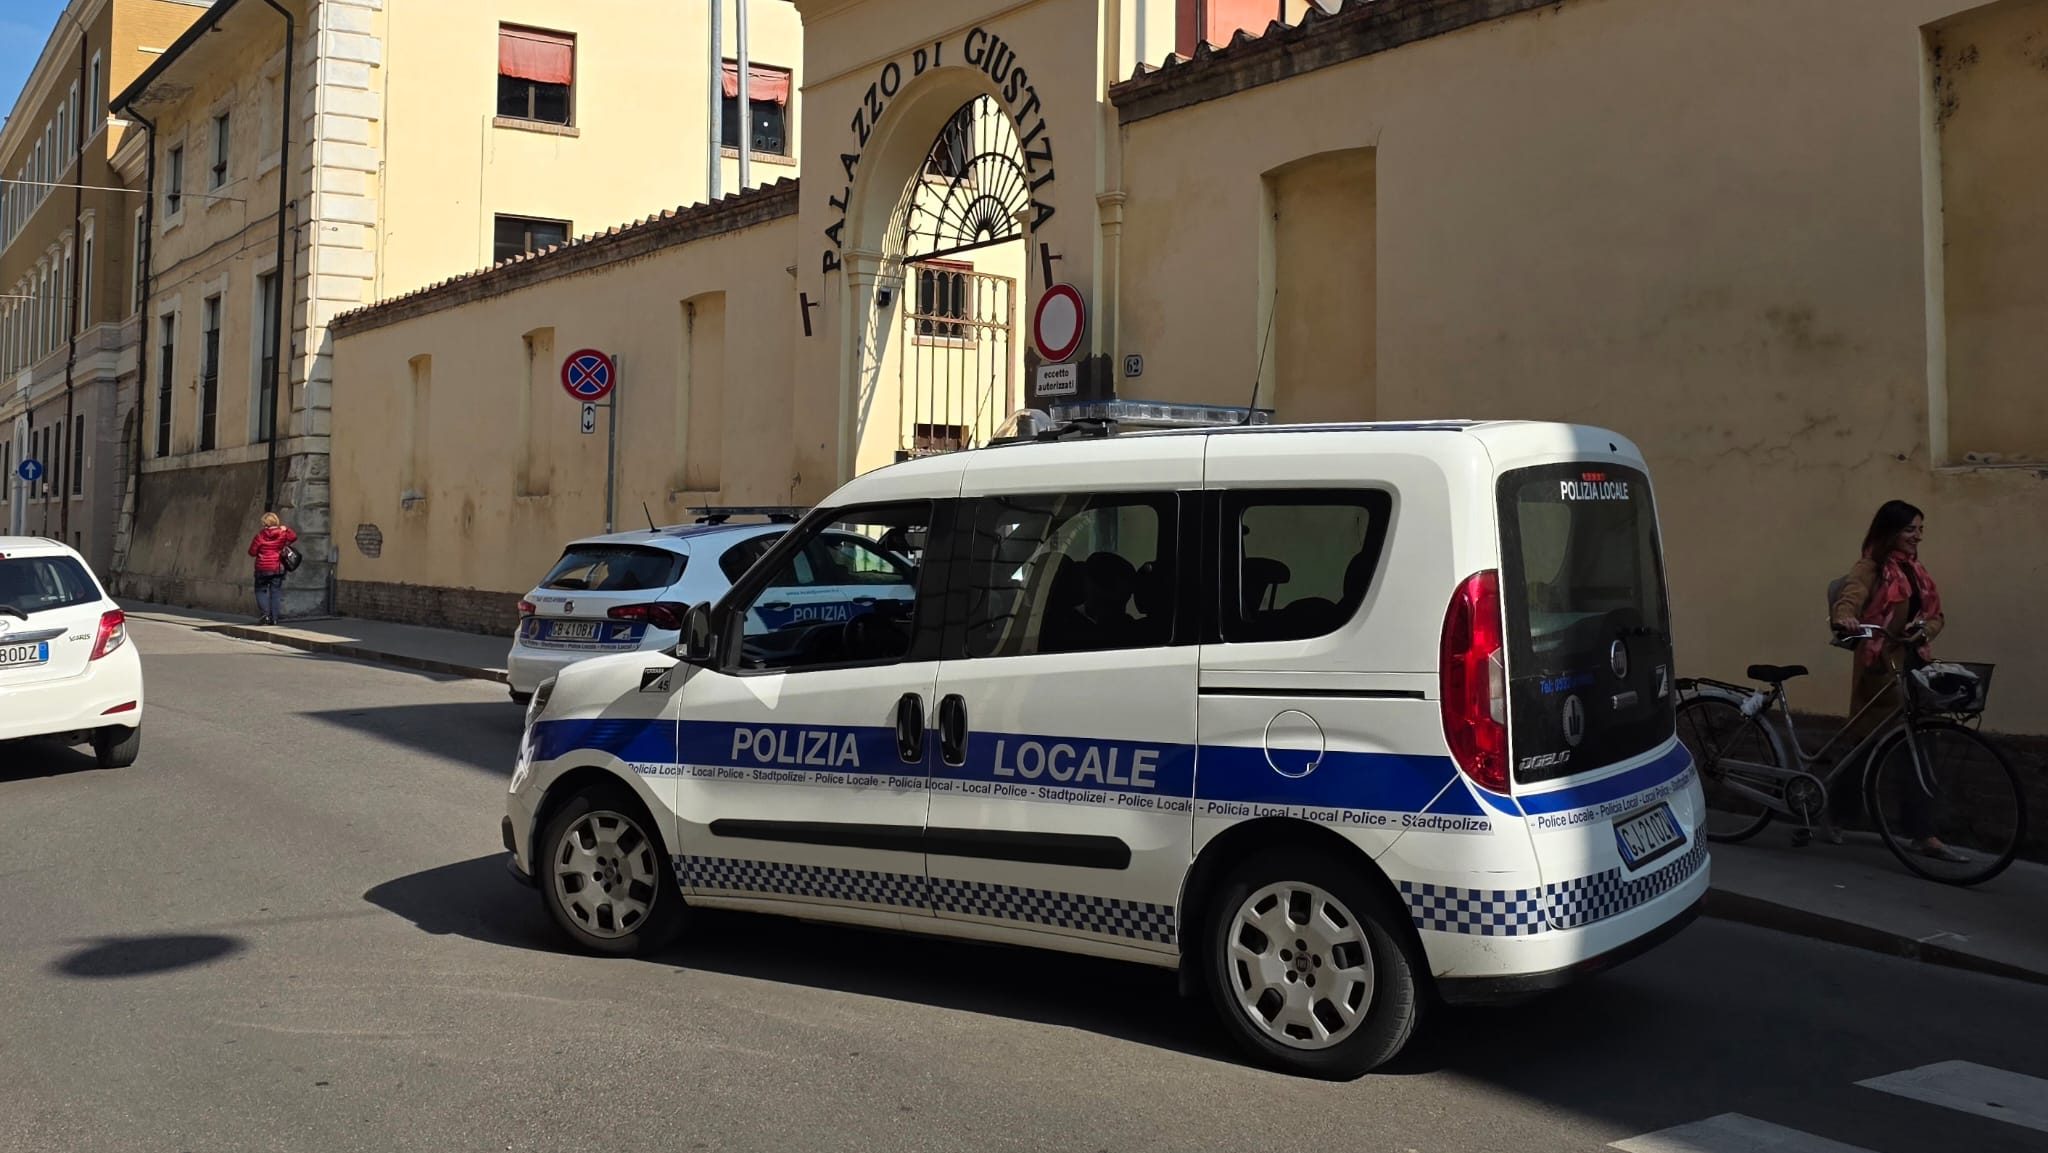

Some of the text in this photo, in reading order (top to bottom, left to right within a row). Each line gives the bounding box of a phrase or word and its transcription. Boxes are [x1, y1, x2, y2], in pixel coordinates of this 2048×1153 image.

[823, 27, 1055, 273] PALAZZO DI GIUSTIZIA
[1044, 368, 1069, 379] eccetto
[1126, 358, 1139, 373] 62
[1038, 380, 1074, 391] autorizzati
[1560, 481, 1629, 500] POLIZIA LOCALE
[793, 605, 847, 621] POLIZIA
[657, 680, 669, 690] 45
[731, 727, 1160, 788] POLIZIA LOCALE
[659, 765, 685, 776] Local
[692, 767, 715, 777] Local
[718, 768, 744, 779] Police
[752, 770, 806, 783] Stadtpolizei
[815, 773, 845, 785] Police
[847, 775, 879, 787] Locale
[924, 779, 953, 791] Local
[962, 781, 991, 794] Local
[994, 785, 1027, 797] Police
[1038, 787, 1107, 804] Stadtpolizei
[1118, 794, 1153, 808] Police
[1156, 799, 1193, 813] Locale
[1253, 805, 1289, 817] Local
[1302, 808, 1338, 822] Local
[1342, 812, 1387, 825] Police
[1401, 814, 1492, 832] Stadtpolizei
[1538, 816, 1567, 829] Police
[1568, 808, 1595, 825] Locale
